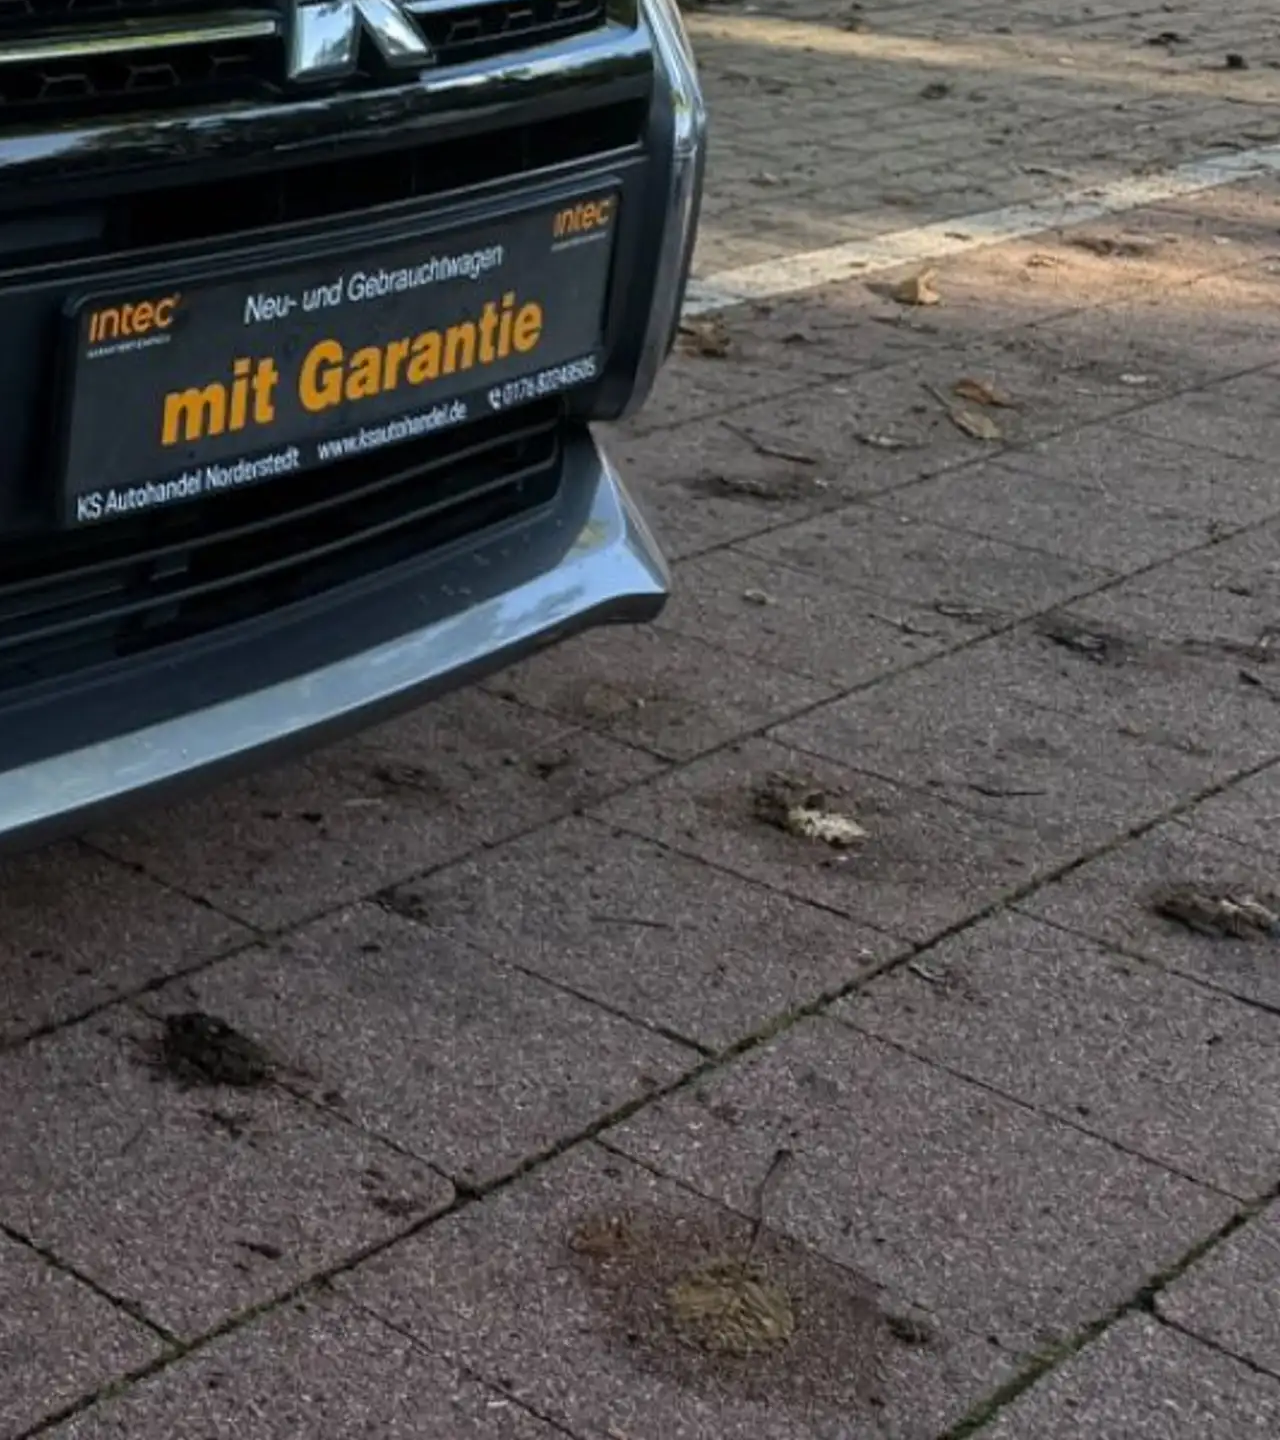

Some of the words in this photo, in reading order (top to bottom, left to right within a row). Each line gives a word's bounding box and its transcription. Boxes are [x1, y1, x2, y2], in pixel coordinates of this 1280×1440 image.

[243, 293, 298, 325] Neu-
[303, 280, 342, 313] und
[347, 244, 505, 302] Gebrauchtwagen
[160, 356, 280, 446] mit
[297, 291, 544, 412] Garantie
[316, 398, 468, 461] www.ksautohandel.de
[76, 492, 104, 522] KS
[104, 466, 202, 517] Autohandel
[205, 445, 301, 490] Norderstedt
